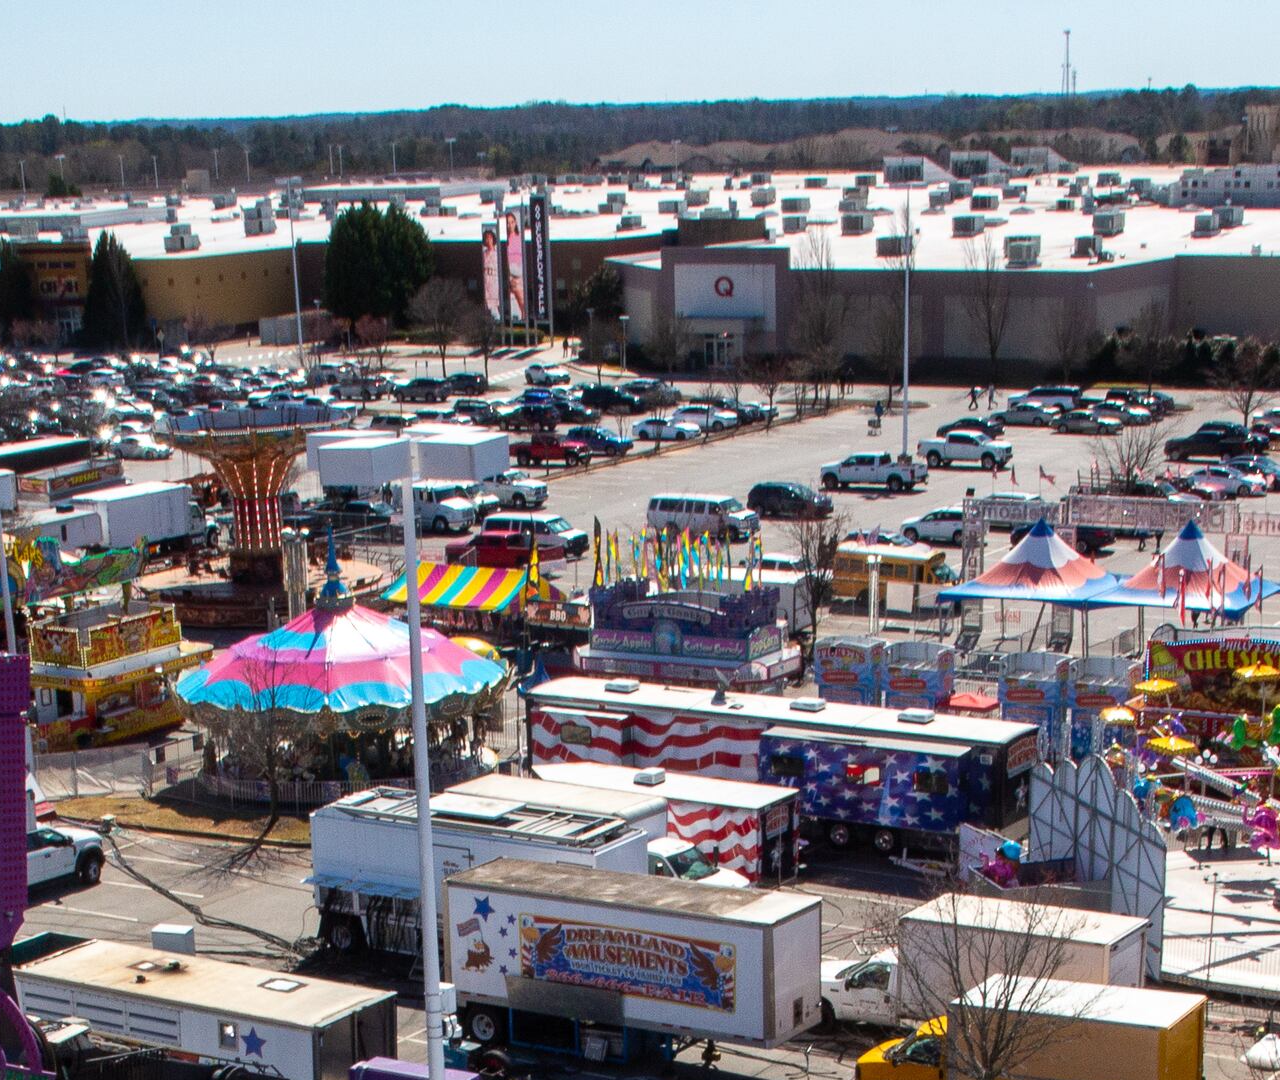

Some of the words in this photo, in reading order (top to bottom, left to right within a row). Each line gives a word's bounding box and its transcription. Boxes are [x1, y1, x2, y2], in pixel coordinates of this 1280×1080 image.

[714, 276, 734, 298] Q
[565, 928, 687, 958] DREAMLAND
[564, 943, 689, 977] AMUSEMENTS
